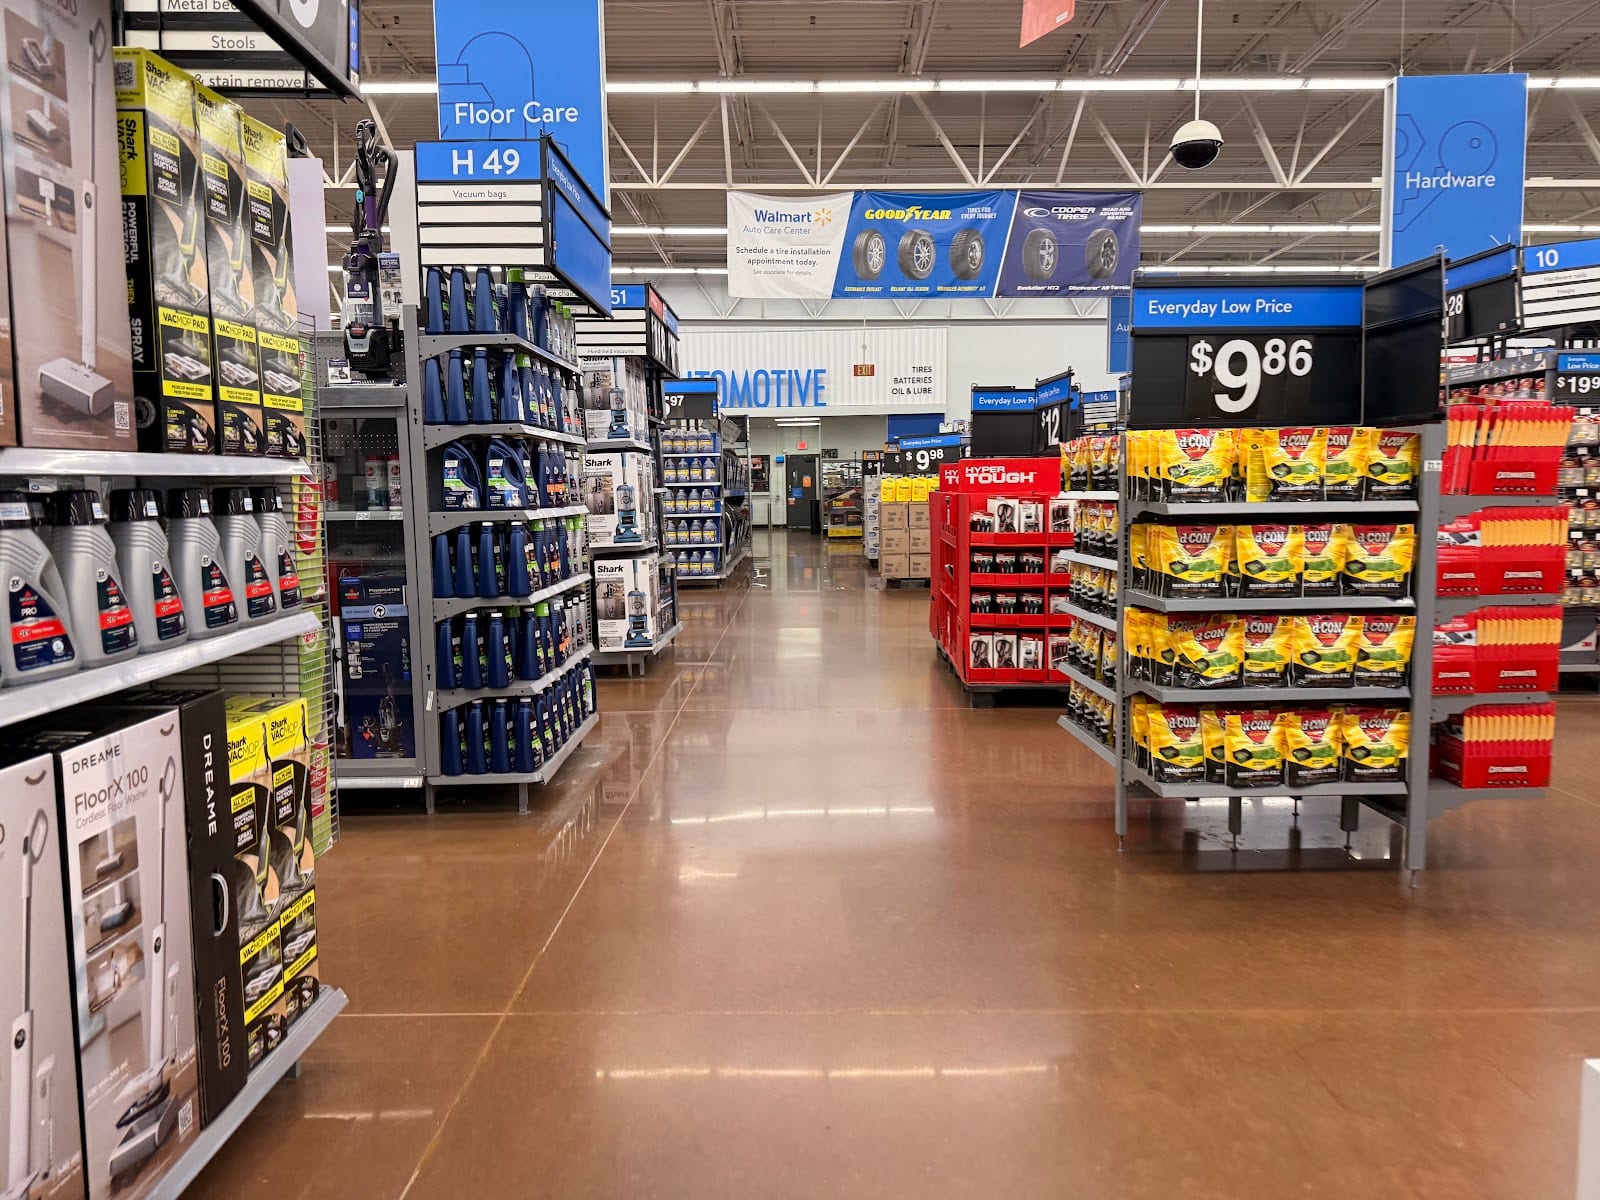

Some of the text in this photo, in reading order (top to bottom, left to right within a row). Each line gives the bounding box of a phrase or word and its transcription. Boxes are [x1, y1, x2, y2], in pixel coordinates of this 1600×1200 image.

[211, 35, 256, 49] Stools
[146, 60, 170, 81] Shark
[209, 74, 244, 88] stain
[454, 100, 579, 125] Floor Care
[243, 123, 264, 142] Shark
[452, 148, 521, 175] H 49
[1405, 171, 1496, 189] Hardware
[452, 188, 507, 200] Vacuum bags
[754, 209, 812, 223] Walmart
[865, 206, 952, 222] GOODYEAR
[1051, 206, 1096, 214] COOPER
[128, 202, 140, 264] POWERFUL
[742, 225, 811, 235] Auto Care Center
[735, 246, 768, 254] Schedule
[776, 247, 788, 255] tire
[790, 247, 831, 255] installation
[747, 257, 818, 267] appointment today.
[1535, 249, 1559, 267] 10
[128, 278, 136, 304] THEN
[610, 289, 627, 305] 51
[1148, 299, 1293, 318] Everyday Low Price
[1448, 294, 1463, 316] 28
[163, 312, 206, 330] VACMOP PAD
[218, 323, 254, 339] VACMOP PAD
[131, 318, 144, 364] SPRAY
[261, 335, 297, 351] VACMOP PAD
[857, 365, 871, 376] EXIT
[893, 376, 933, 384] BATTERIES
[891, 387, 905, 395] OIL
[906, 387, 912, 395] &
[1100, 393, 1108, 401] 16
[979, 396, 1038, 406] Everyday Low Pri
[1180, 434, 1211, 449] d-CON
[1280, 435, 1309, 446] d-CON
[585, 459, 612, 467] Shark
[965, 465, 1006, 473] HYPER
[965, 472, 1034, 484] TOUGH
[1180, 532, 1211, 543] d-CON
[1255, 531, 1285, 542] d-CON
[1357, 532, 1390, 543] d-CON
[597, 565, 624, 573] Shark
[211, 578, 221, 587] PRO
[162, 586, 172, 595] PRO
[109, 596, 120, 604] PRO
[21, 606, 37, 617] PRO
[1312, 621, 1344, 634] d-CON
[1195, 628, 1227, 642] d-CON
[271, 716, 288, 731] Shark
[1168, 717, 1198, 728] d-CON
[1243, 719, 1271, 731] d-CON
[1302, 718, 1328, 730] d-CON
[1360, 718, 1391, 729] d-CON
[271, 720, 298, 741] VACMOP
[227, 736, 247, 751] Shark
[227, 740, 260, 763] VACMOP
[72, 744, 121, 774] DREAME
[74, 765, 149, 815] FloorX 100
[203, 733, 217, 837] DREAME
[76, 788, 149, 829] Cordless Floor Washer
[234, 813, 255, 830] SUCTION
[282, 895, 312, 924] VACMOP PAD
[243, 927, 278, 958] VACMOP PAD
[217, 976, 229, 1035] FloorX
[222, 1037, 231, 1067] 100
